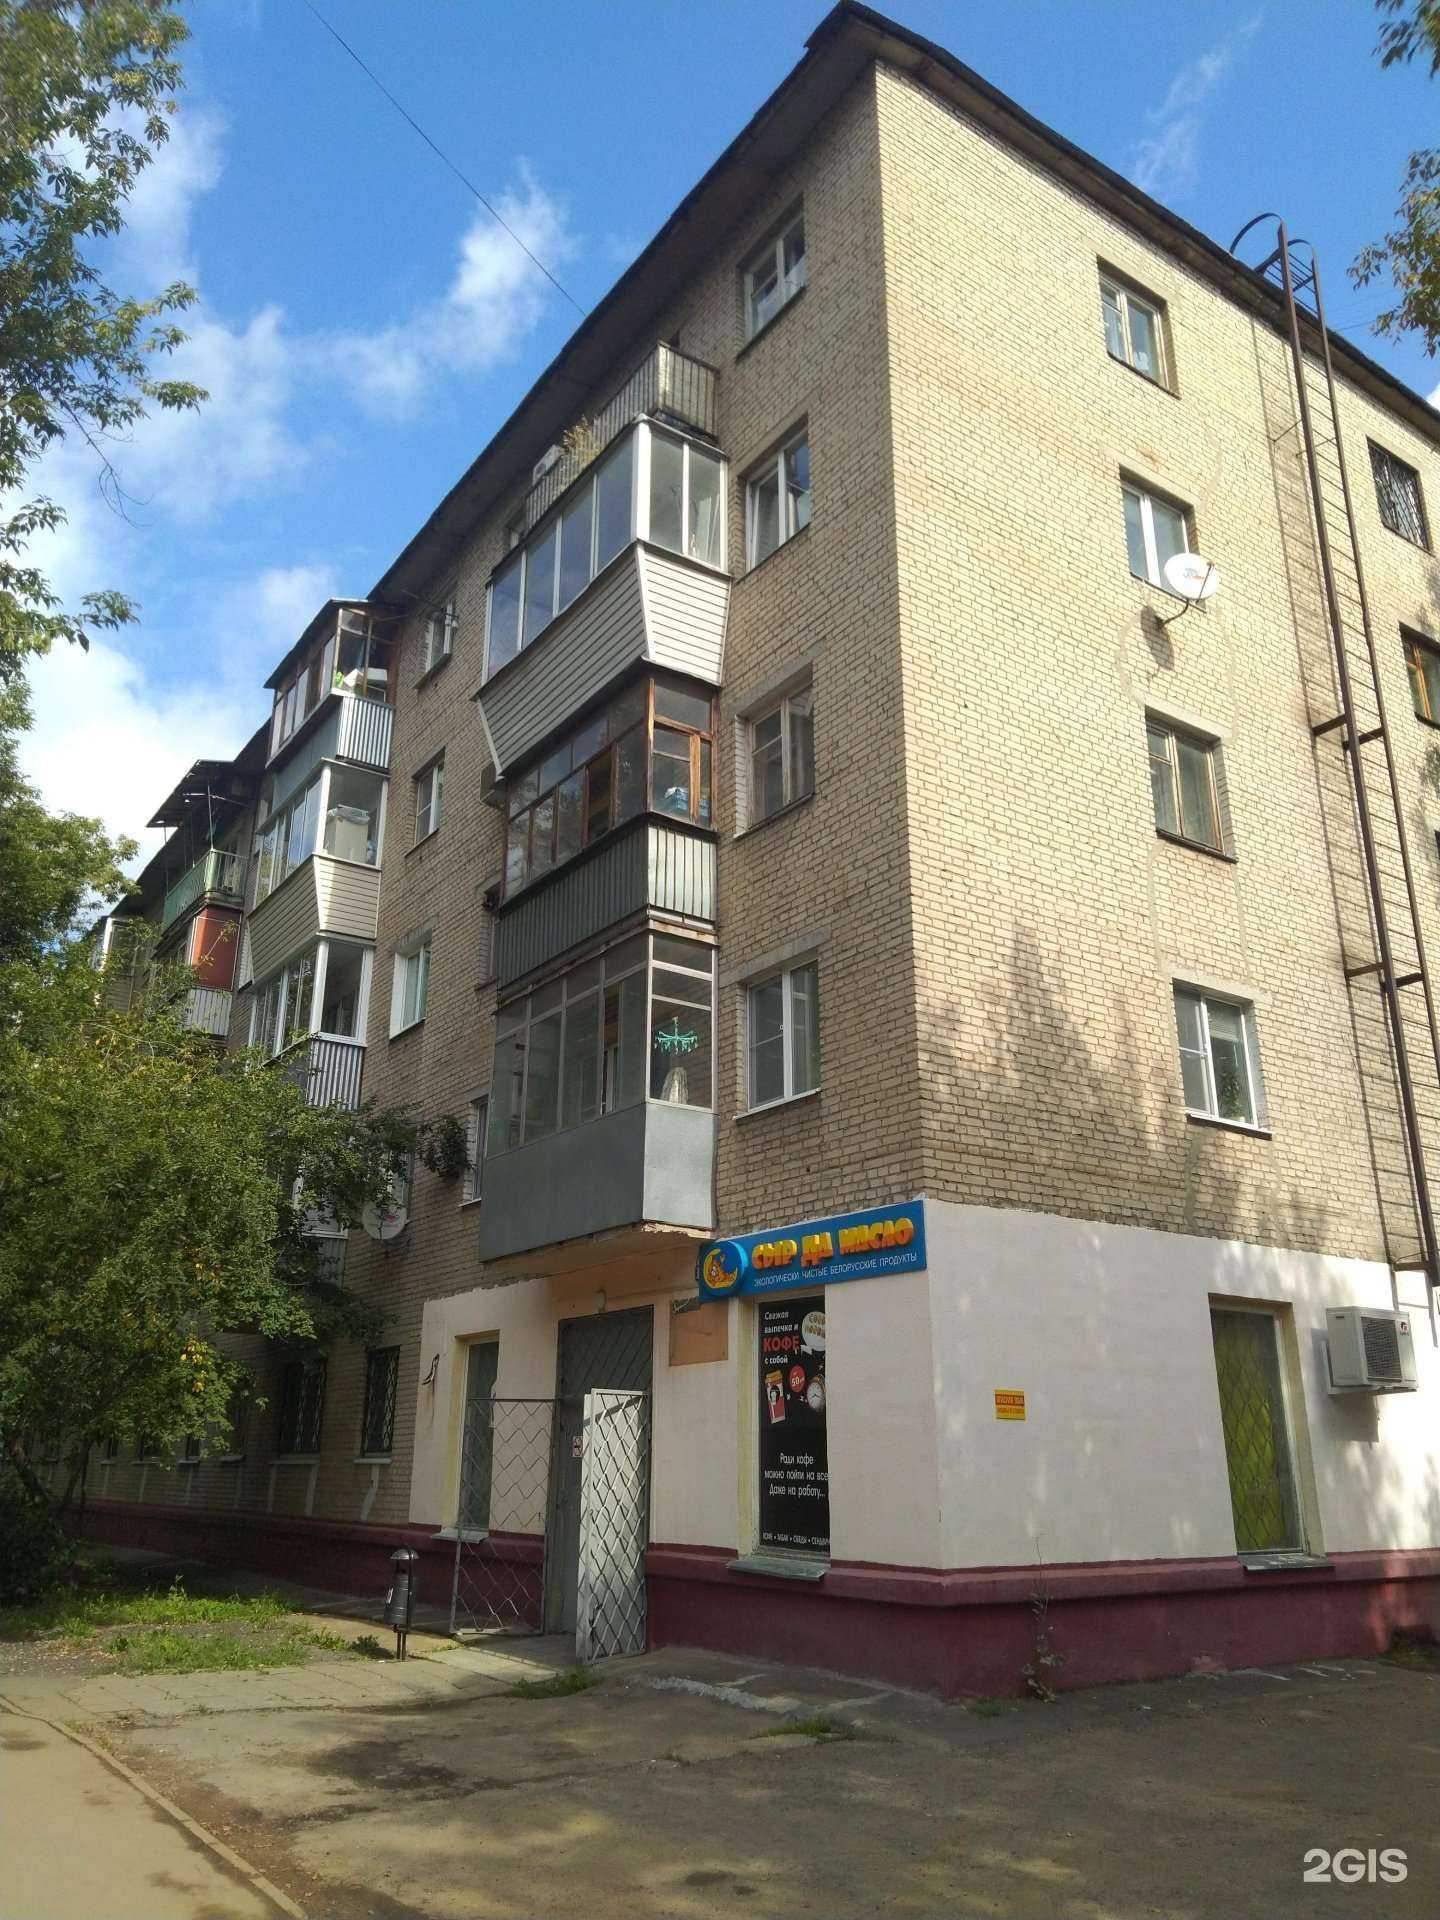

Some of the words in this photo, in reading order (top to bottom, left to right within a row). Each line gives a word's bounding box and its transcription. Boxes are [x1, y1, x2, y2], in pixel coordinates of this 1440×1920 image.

[751, 1239, 798, 1270] СЫР
[801, 1232, 834, 1267] ДА
[838, 1217, 915, 1255] МАСЛО
[753, 1271, 800, 1288] ЭКОЛОГИЧЕСКИ
[801, 1266, 829, 1281] ЧИСТЫЕ
[830, 1259, 878, 1276] БЕЛОРУССКИЕ
[879, 1252, 918, 1268] ПРОДУКТЫ
[764, 1324, 793, 1333] выпечка
[763, 1335, 800, 1352] КОФЕ
[769, 1355, 789, 1364] собой
[780, 1452, 795, 1464] Ради
[796, 1452, 814, 1467] кофе
[764, 1470, 785, 1479] можно
[786, 1469, 804, 1480] пойти
[806, 1471, 815, 1480] на
[769, 1483, 786, 1496] Даже
[787, 1486, 796, 1496] на
